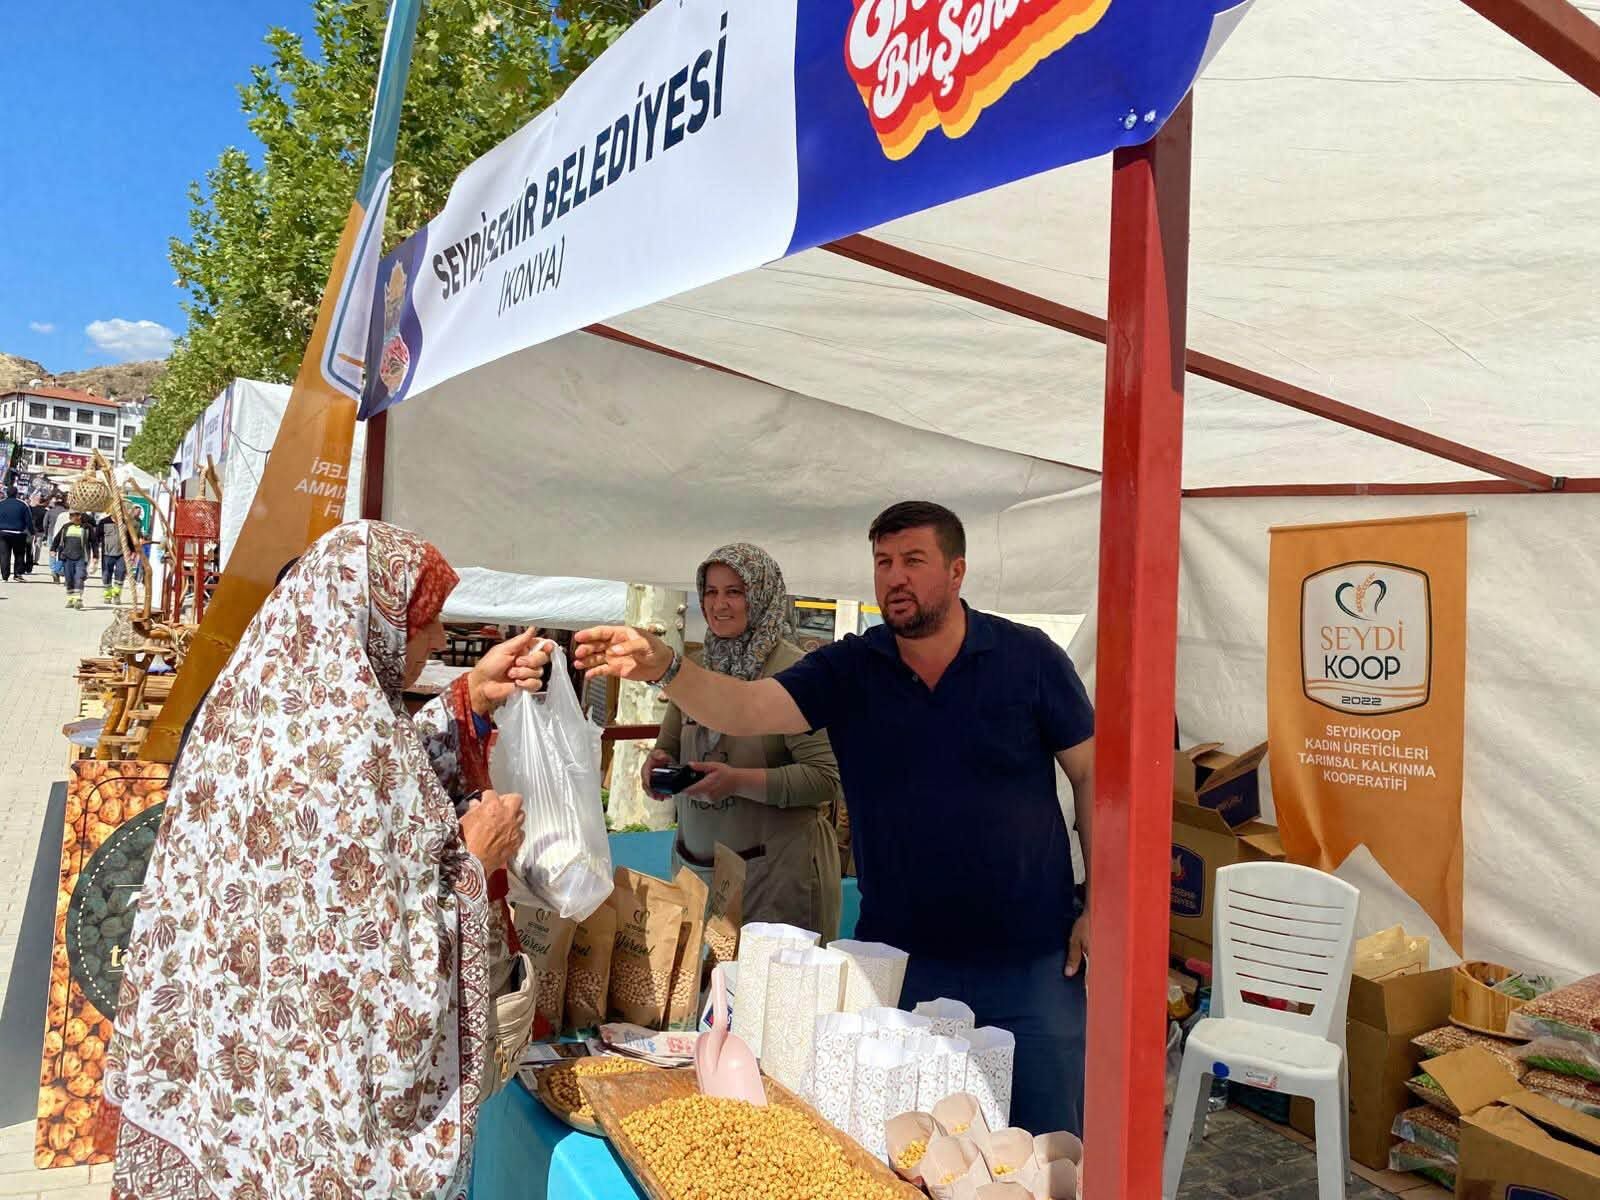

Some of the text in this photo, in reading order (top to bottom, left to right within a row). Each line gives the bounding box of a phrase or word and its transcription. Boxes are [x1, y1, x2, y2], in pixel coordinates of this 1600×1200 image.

[873, 27, 932, 119] Bu
[432, 12, 729, 301] SEYDİŞEHİR BELEDİYESİ
[498, 234, 566, 319] (KONYA)
[1320, 621, 1406, 651] SEYDİ
[1324, 655, 1400, 680] KOOP
[1341, 695, 1382, 706] 2022
[1326, 724, 1401, 741] SEYDİKOOP
[1305, 738, 1429, 761] KADIN ÜRETİCİLERİ
[1297, 752, 1436, 778] TARIMSAL KALKINMA
[1323, 771, 1407, 791] KOOPERATİFİ
